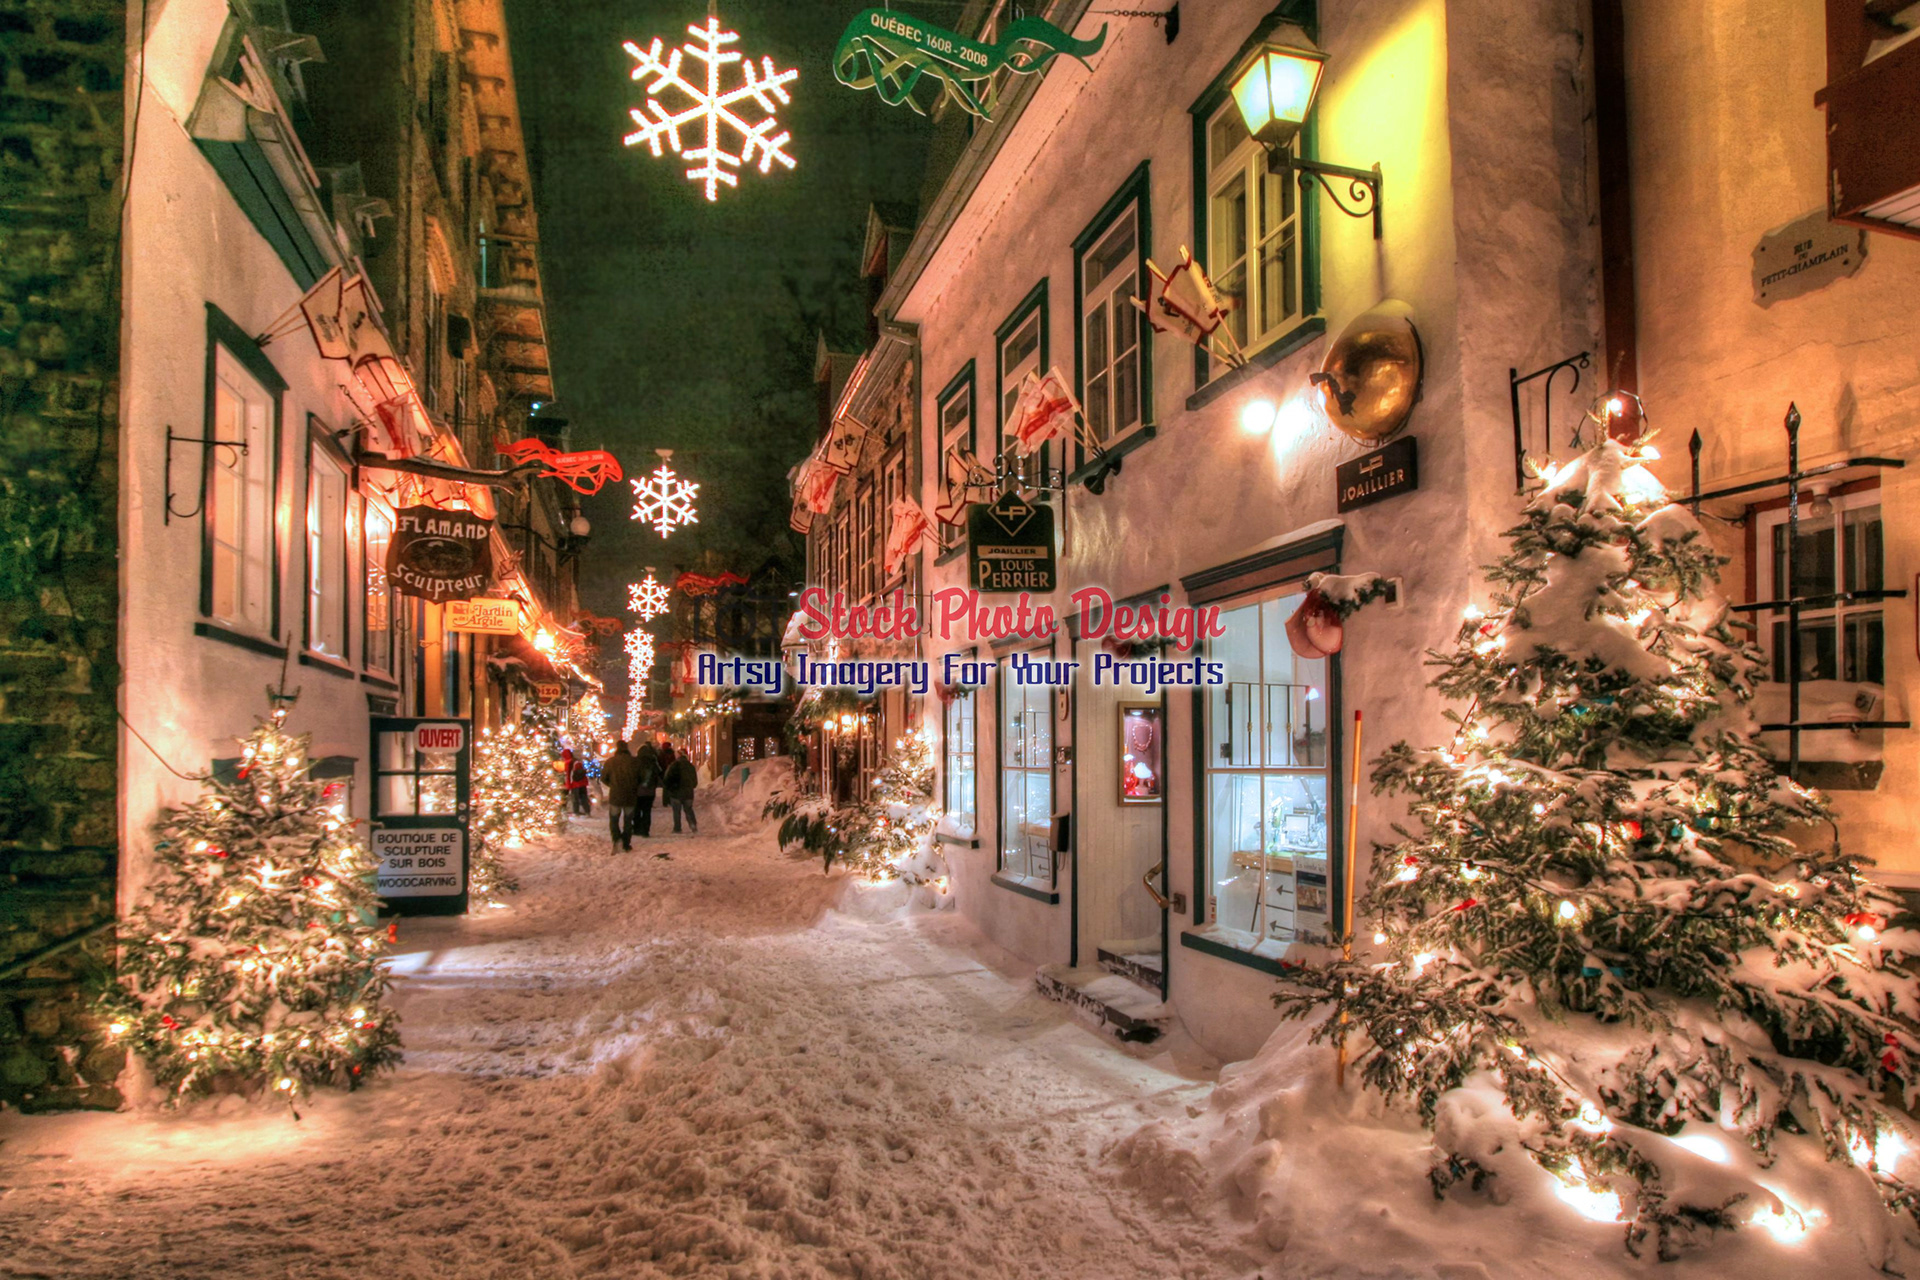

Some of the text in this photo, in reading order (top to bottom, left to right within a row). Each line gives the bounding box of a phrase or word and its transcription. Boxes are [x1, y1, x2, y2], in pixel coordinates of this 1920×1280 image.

[871, 13, 922, 42] QUÉBEC
[1794, 240, 1813, 255] RUE
[1761, 244, 1848, 287] PETIT-CHAMPLAIN
[1342, 469, 1404, 503] JOAILLIER
[398, 516, 488, 540] FLAMAND
[1001, 560, 1035, 571] LOUIS
[391, 563, 484, 600] Sculpteur
[979, 561, 1049, 588] PERRIER
[473, 604, 513, 617] Jardin
[469, 616, 503, 628] Argile
[418, 728, 461, 748] OUVERT
[377, 833, 457, 844] BOUTIQUE DE
[384, 846, 451, 856] SCULPTURE
[389, 858, 446, 869] SUR BOIS
[378, 876, 457, 888] WOODCARVING
